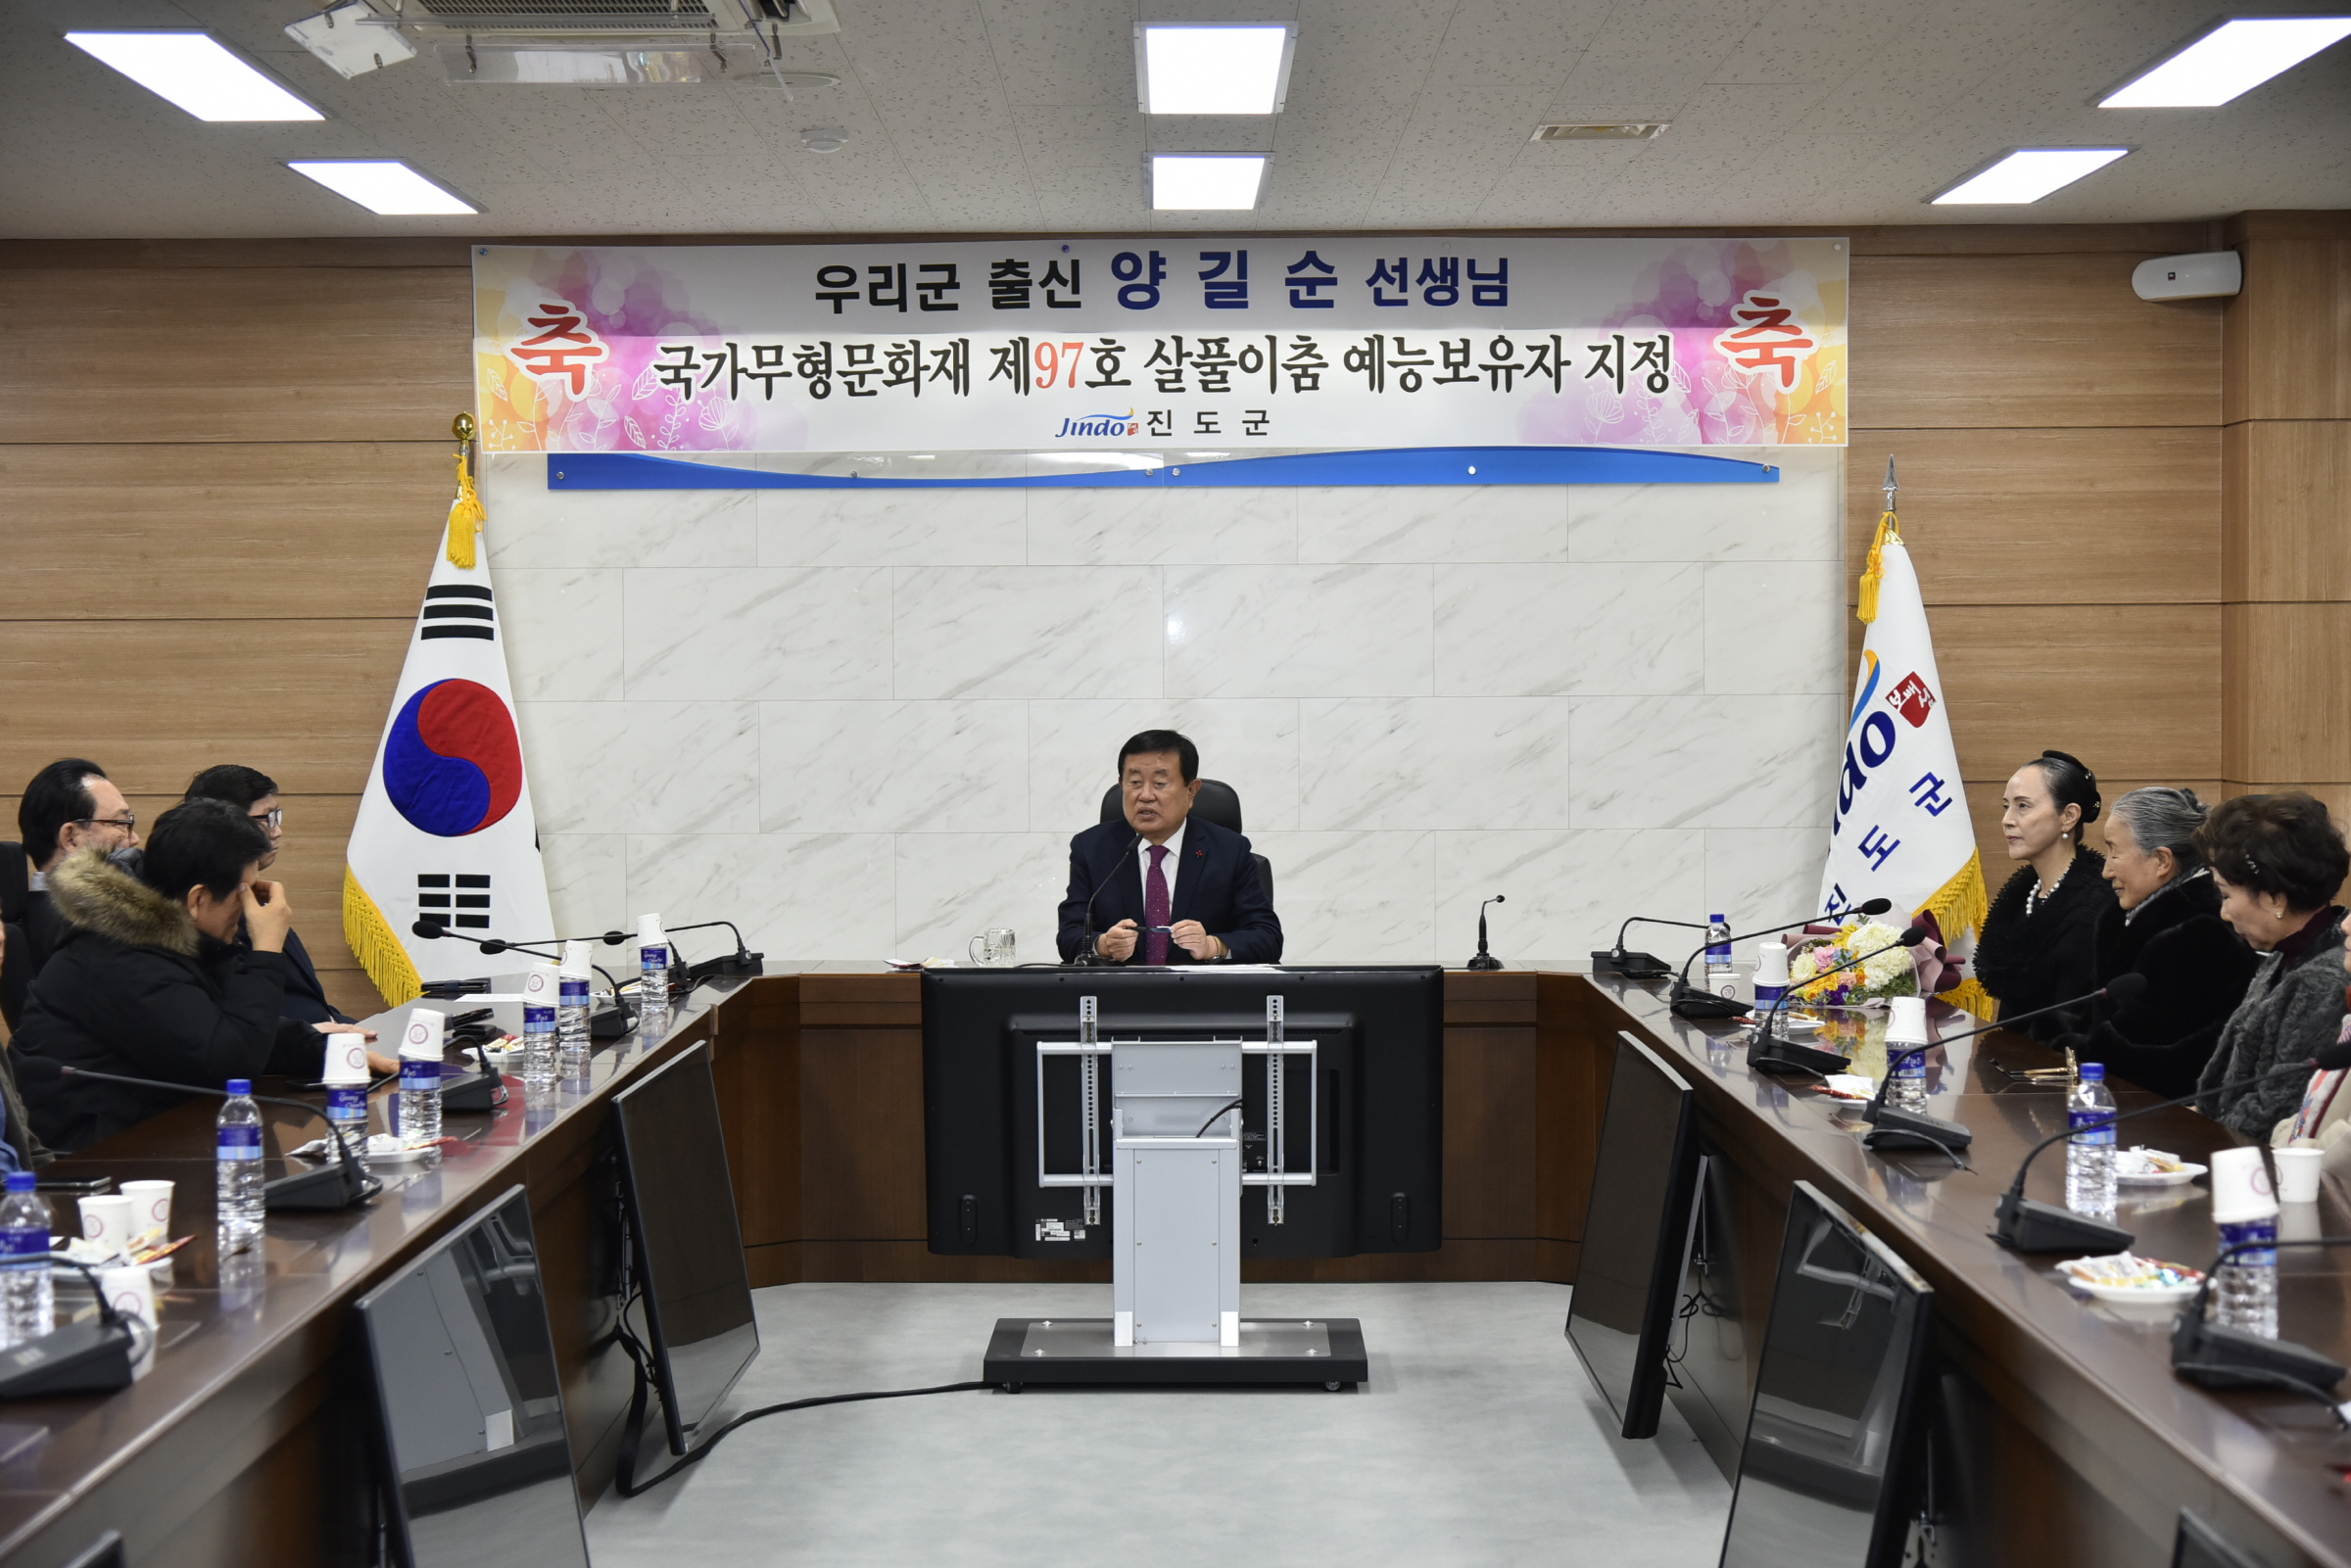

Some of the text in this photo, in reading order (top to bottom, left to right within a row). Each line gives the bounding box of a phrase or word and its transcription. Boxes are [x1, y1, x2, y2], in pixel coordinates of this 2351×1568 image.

[815, 251, 1509, 314] 우리군 출신 양 길 순 선생님
[510, 303, 602, 395] 축
[653, 334, 1671, 401] 국가무형문화재 제97호 살풀이춤 예능보유자 지정
[1721, 296, 1814, 388] 축
[1055, 417, 1126, 438] Jindo
[1146, 408, 1173, 437] 진
[1193, 410, 1222, 434] 도
[1242, 409, 1271, 436] 군
[1857, 825, 1901, 872] 도
[1908, 771, 1953, 817] 군
